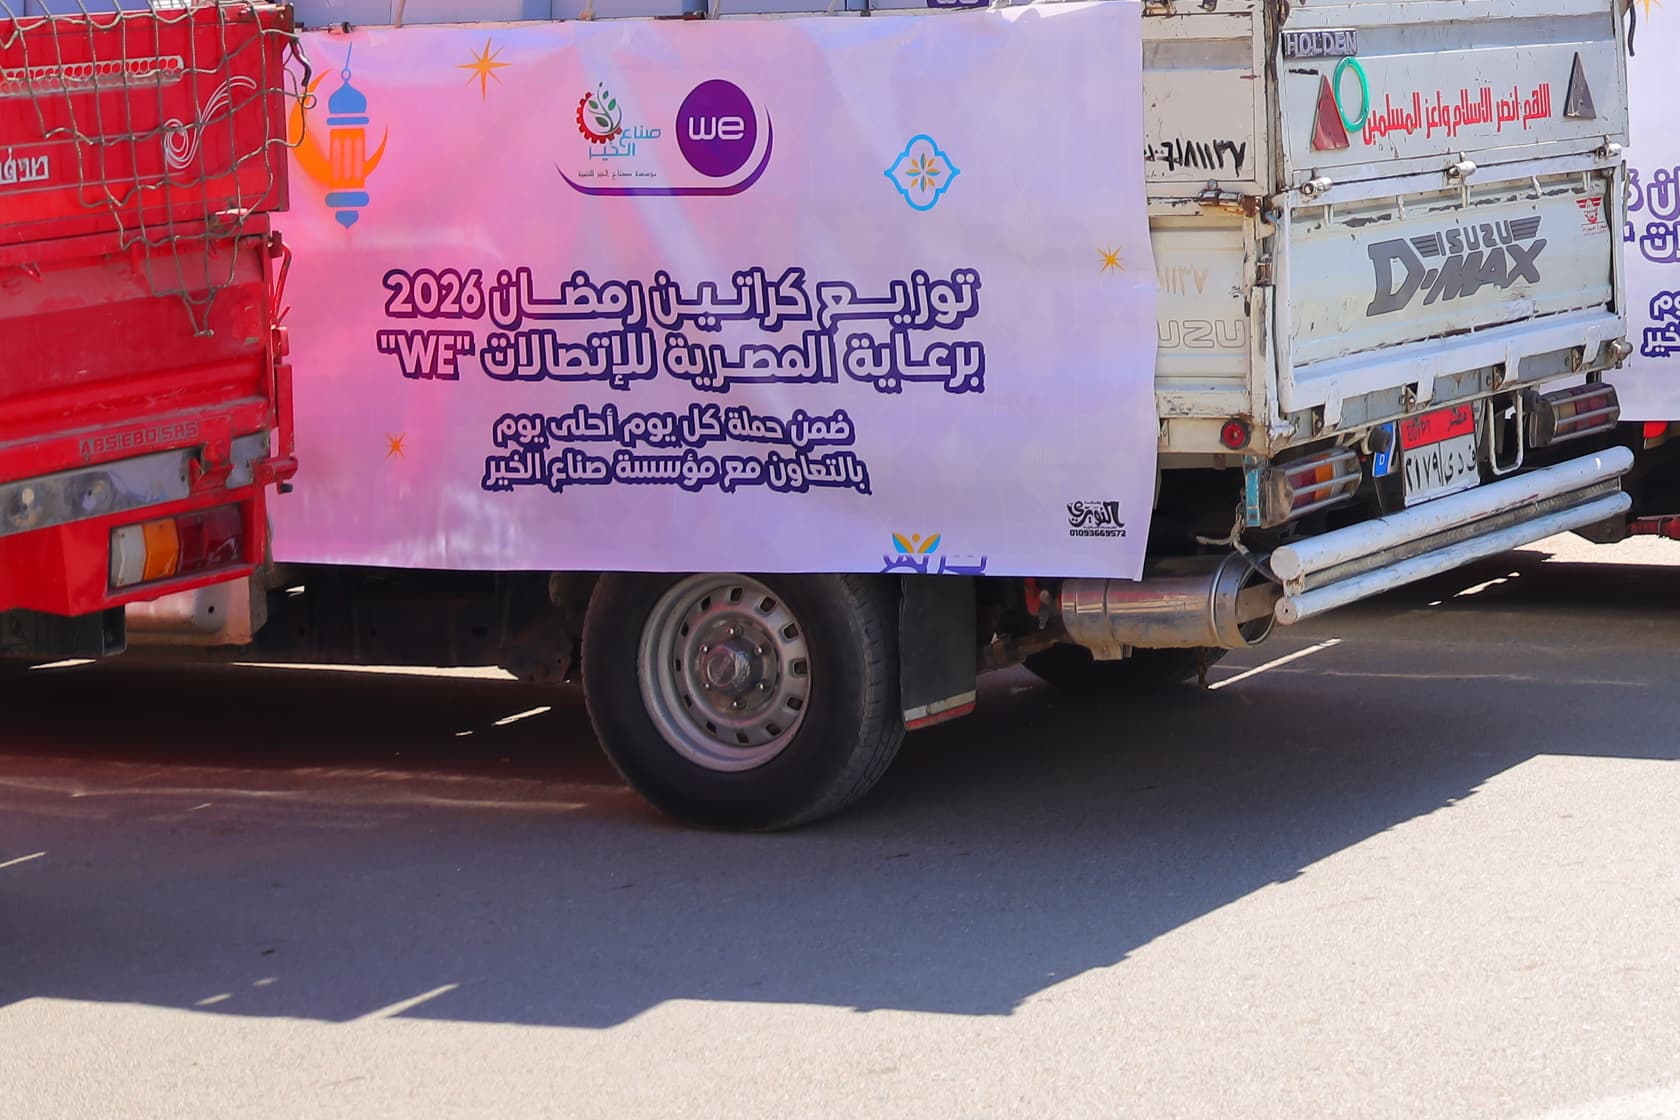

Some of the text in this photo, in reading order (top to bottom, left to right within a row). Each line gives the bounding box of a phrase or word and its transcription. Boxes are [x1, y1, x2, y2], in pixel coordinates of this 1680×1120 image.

[1287, 32, 1358, 57] HOLDEN
[619, 125, 661, 148] صناع
[688, 115, 745, 141] we
[1363, 93, 1422, 146] المسلمين
[589, 141, 635, 161] الخير
[1435, 220, 1512, 257] ISUZU
[384, 268, 981, 329] توزيع كراتين رمضان 2026
[379, 330, 984, 391] برعاية المصرية للإتصالات "WE"
[494, 404, 854, 449] ضمن حملة كل يوم أحلى يوم
[1448, 410, 1468, 432] مصر
[483, 449, 871, 494] بالتعاون مع مؤسسة صناع الخير
[1405, 451, 1441, 493] ٢١٧٩
